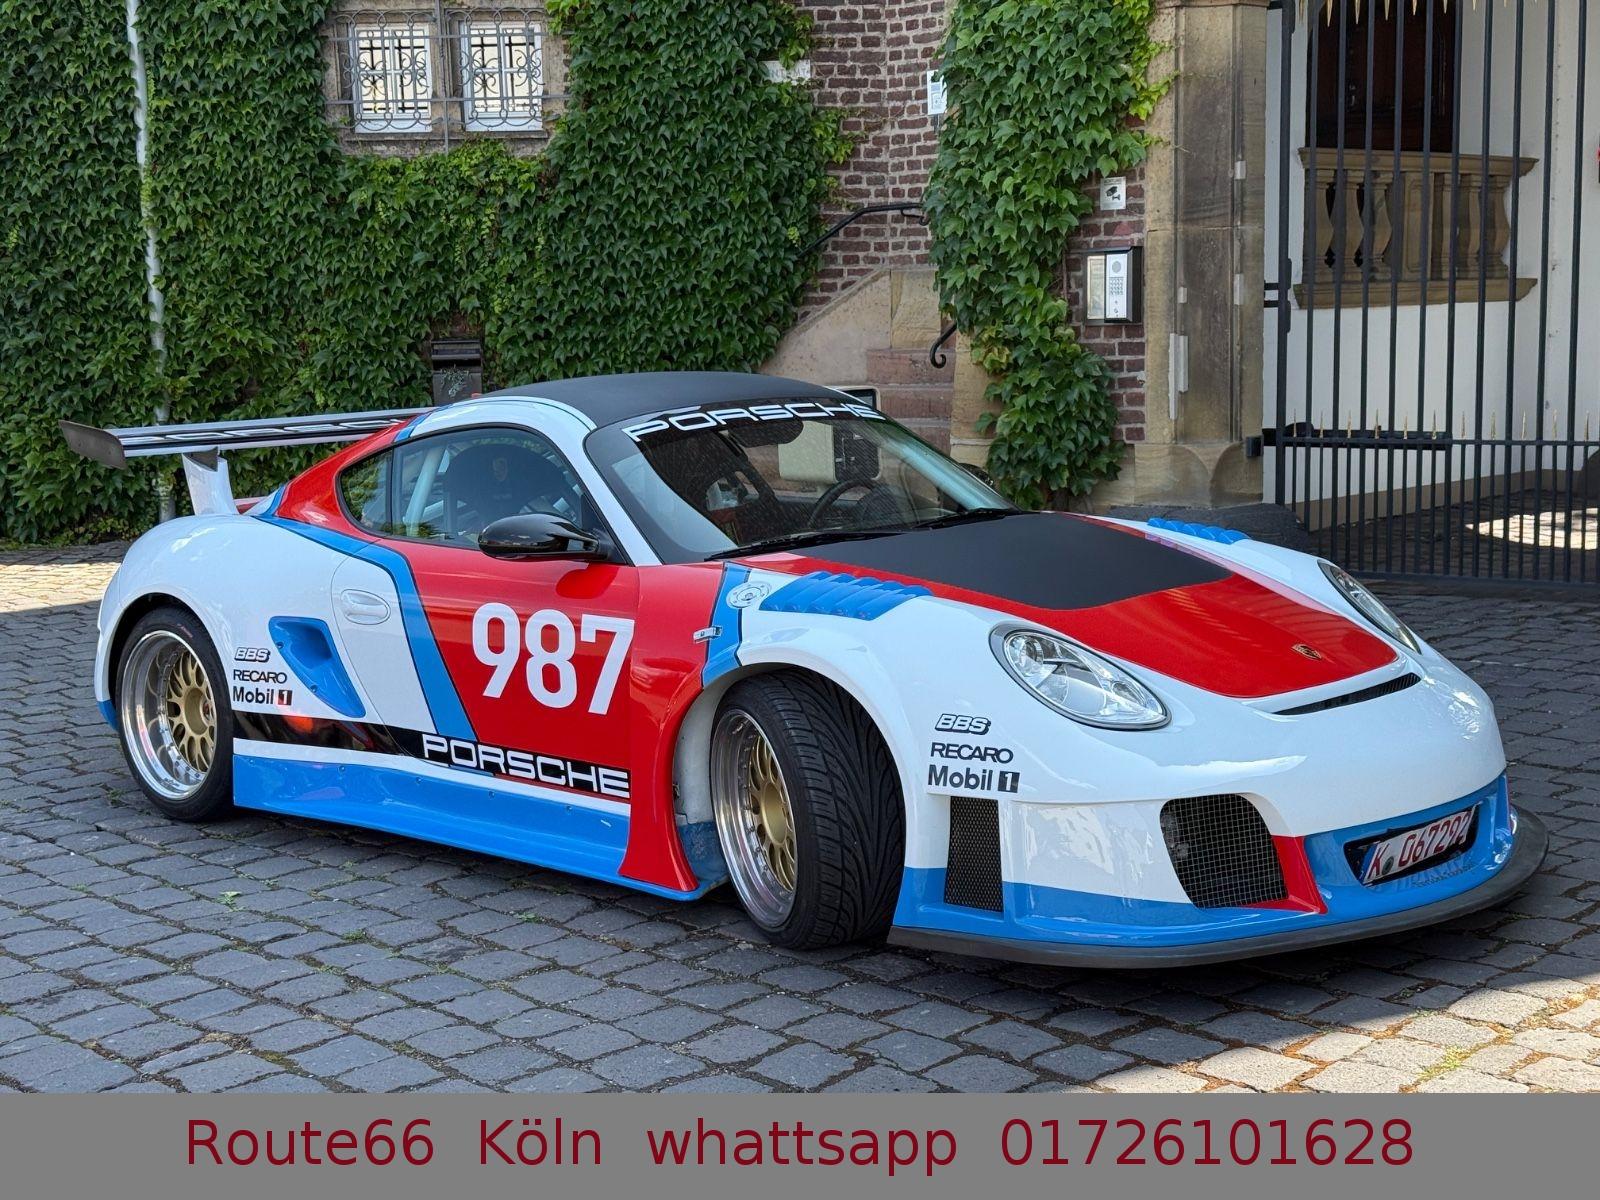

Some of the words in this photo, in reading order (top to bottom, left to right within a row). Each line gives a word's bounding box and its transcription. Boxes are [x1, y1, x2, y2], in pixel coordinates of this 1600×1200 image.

[621, 403, 886, 442] PORSCHE
[234, 647, 271, 662] BBS
[472, 602, 635, 715] 987
[233, 669, 288, 684] RECARO
[232, 686, 275, 704] Mobil
[935, 713, 992, 735] BBS
[930, 742, 1014, 764] RECARO
[422, 734, 631, 798] PORSCHE
[928, 764, 993, 790] Mobil
[1368, 844, 1390, 879] K
